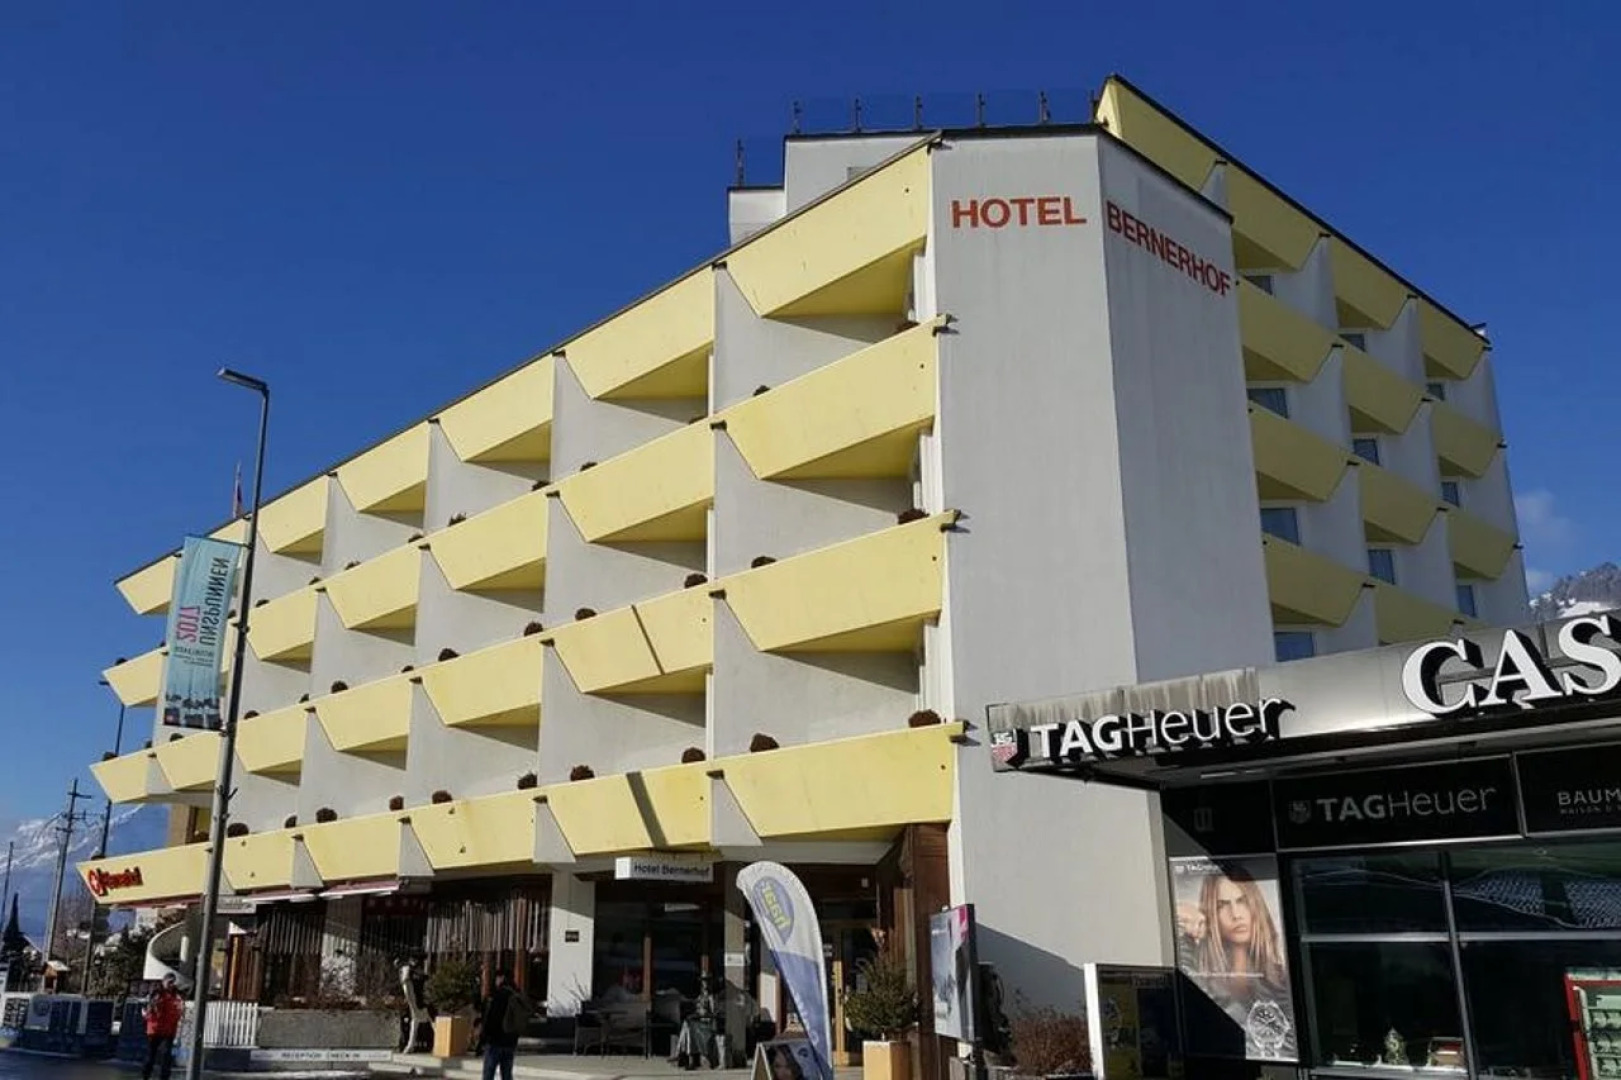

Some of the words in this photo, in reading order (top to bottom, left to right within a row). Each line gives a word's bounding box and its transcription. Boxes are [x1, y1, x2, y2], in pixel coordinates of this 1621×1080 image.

[952, 197, 1087, 229] HOTEL
[1106, 199, 1231, 297] BERNERHOF
[1402, 614, 1621, 715] CAS
[1557, 788, 1621, 805] BAUM
[634, 863, 660, 874] Hotel
[662, 864, 710, 876] Bernerhof
